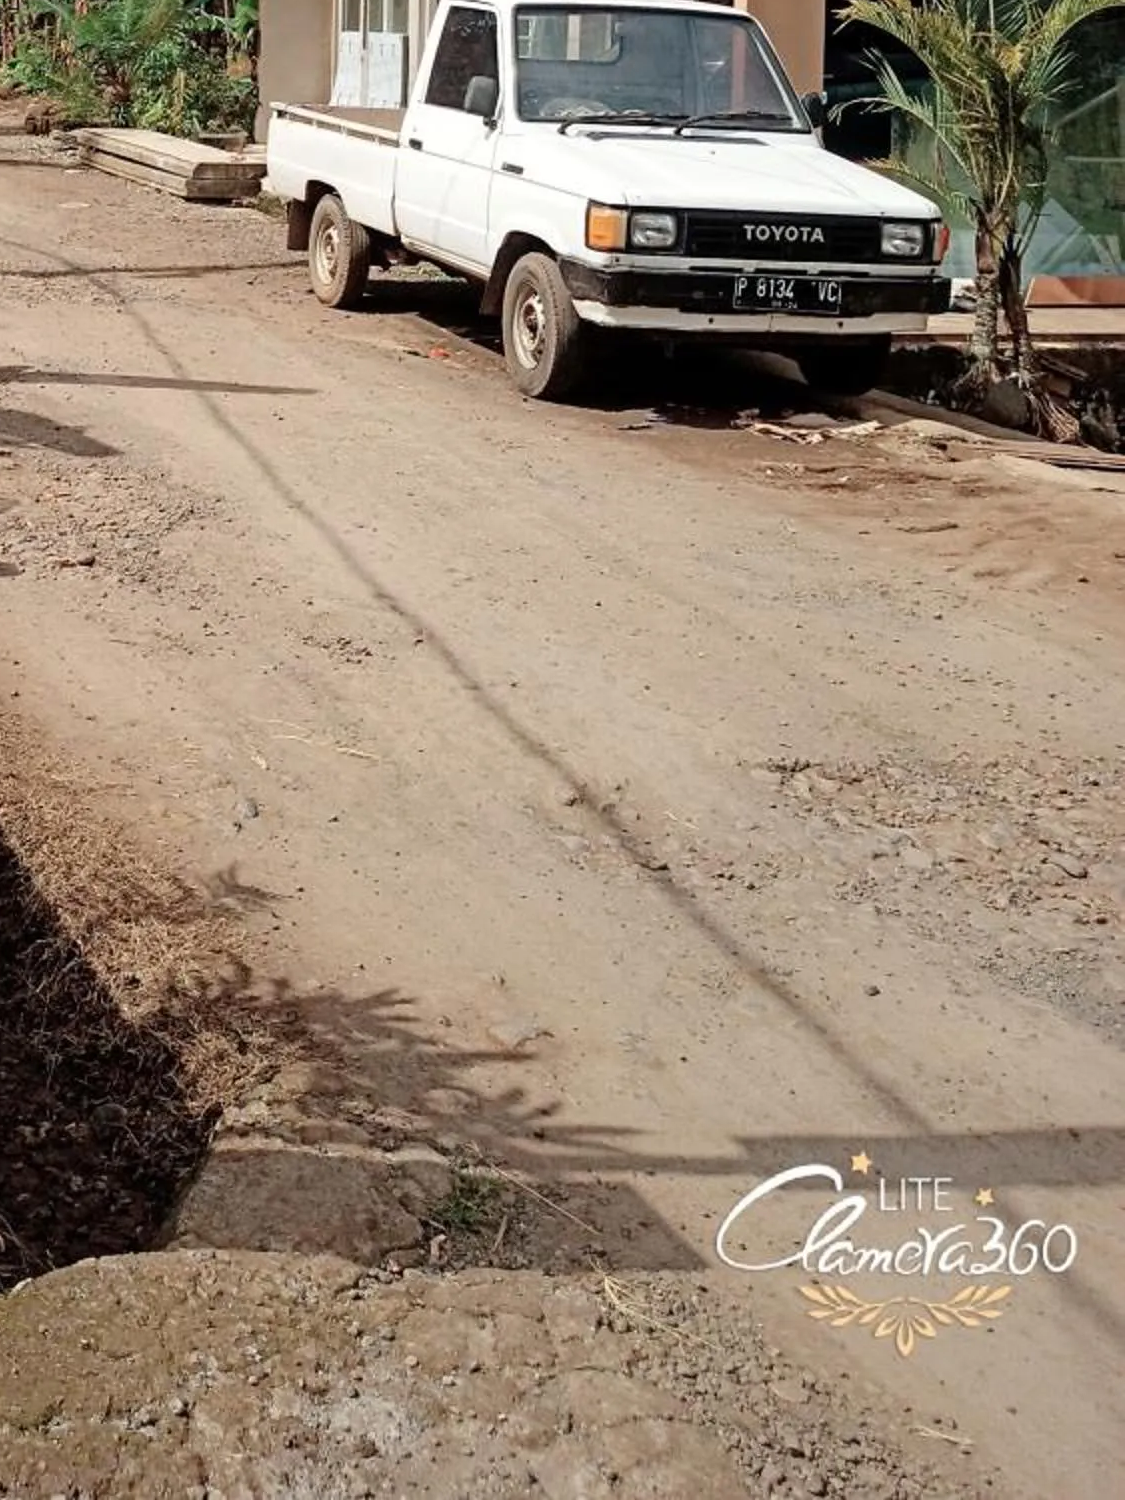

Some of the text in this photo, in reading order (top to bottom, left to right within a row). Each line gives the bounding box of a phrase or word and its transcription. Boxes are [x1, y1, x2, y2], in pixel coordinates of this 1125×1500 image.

[743, 224, 825, 244] TOYOTA
[738, 277, 748, 297] P
[756, 278, 795, 299] 8134
